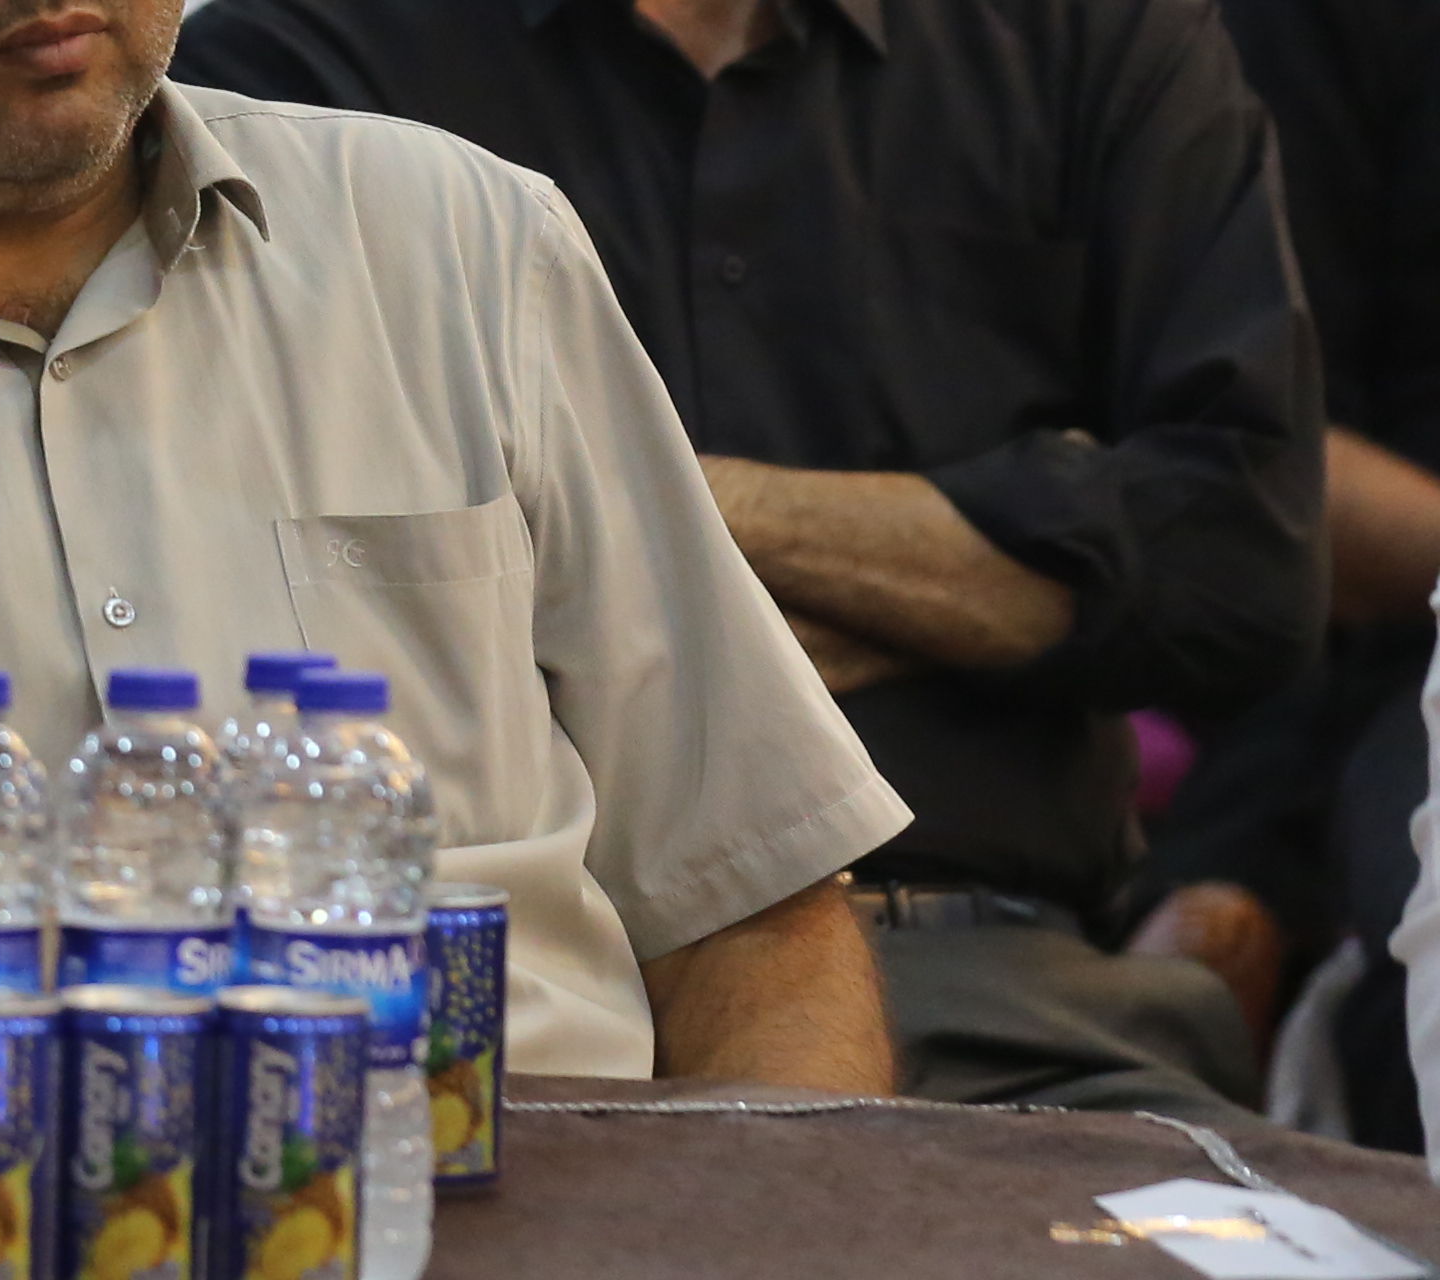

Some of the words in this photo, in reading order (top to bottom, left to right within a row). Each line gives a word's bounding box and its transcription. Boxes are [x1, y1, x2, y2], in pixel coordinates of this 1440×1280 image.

[286, 939, 412, 989] SIRMA
[72, 1039, 128, 1190] Canary
[238, 1038, 298, 1190] Canary
